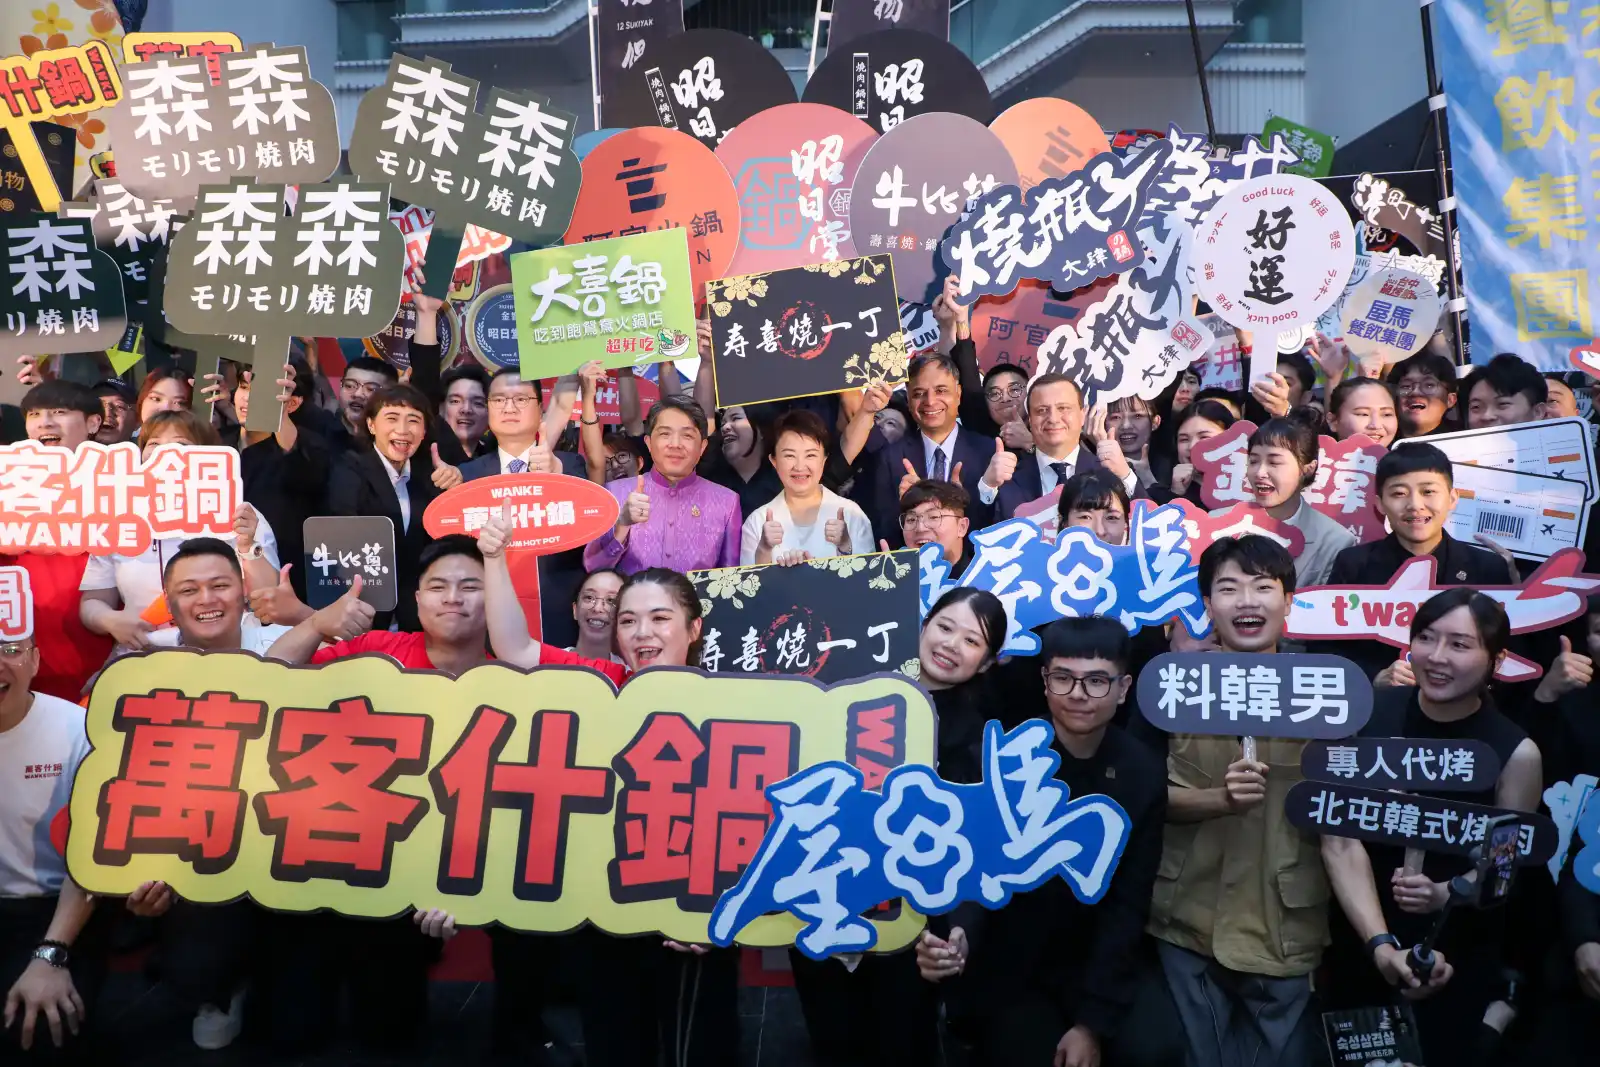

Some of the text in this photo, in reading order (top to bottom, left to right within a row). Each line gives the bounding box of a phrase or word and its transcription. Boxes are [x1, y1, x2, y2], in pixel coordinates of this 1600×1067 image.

[86, 46, 117, 100] WANKE
[127, 49, 310, 146] 森森
[670, 56, 735, 150] 昭日
[380, 64, 568, 190] 森森
[1242, 187, 1295, 203] Good Luck
[194, 185, 382, 276] 森森
[1245, 206, 1296, 305] 好運
[530, 253, 667, 322] 大喜鍋
[1246, 310, 1298, 324] Good Luck
[1346, 318, 1417, 350] 餐飲集團
[1365, 299, 1414, 329] 屋馬
[605, 336, 655, 354] 超好吃
[491, 486, 542, 499] WANKE
[0, 522, 138, 548] WANKE
[524, 537, 540, 546] HOT
[542, 536, 560, 545] POT
[1158, 663, 1348, 724] 料韓男
[1326, 745, 1475, 782] 專人代烤
[98, 689, 794, 898] 萬客什鍋
